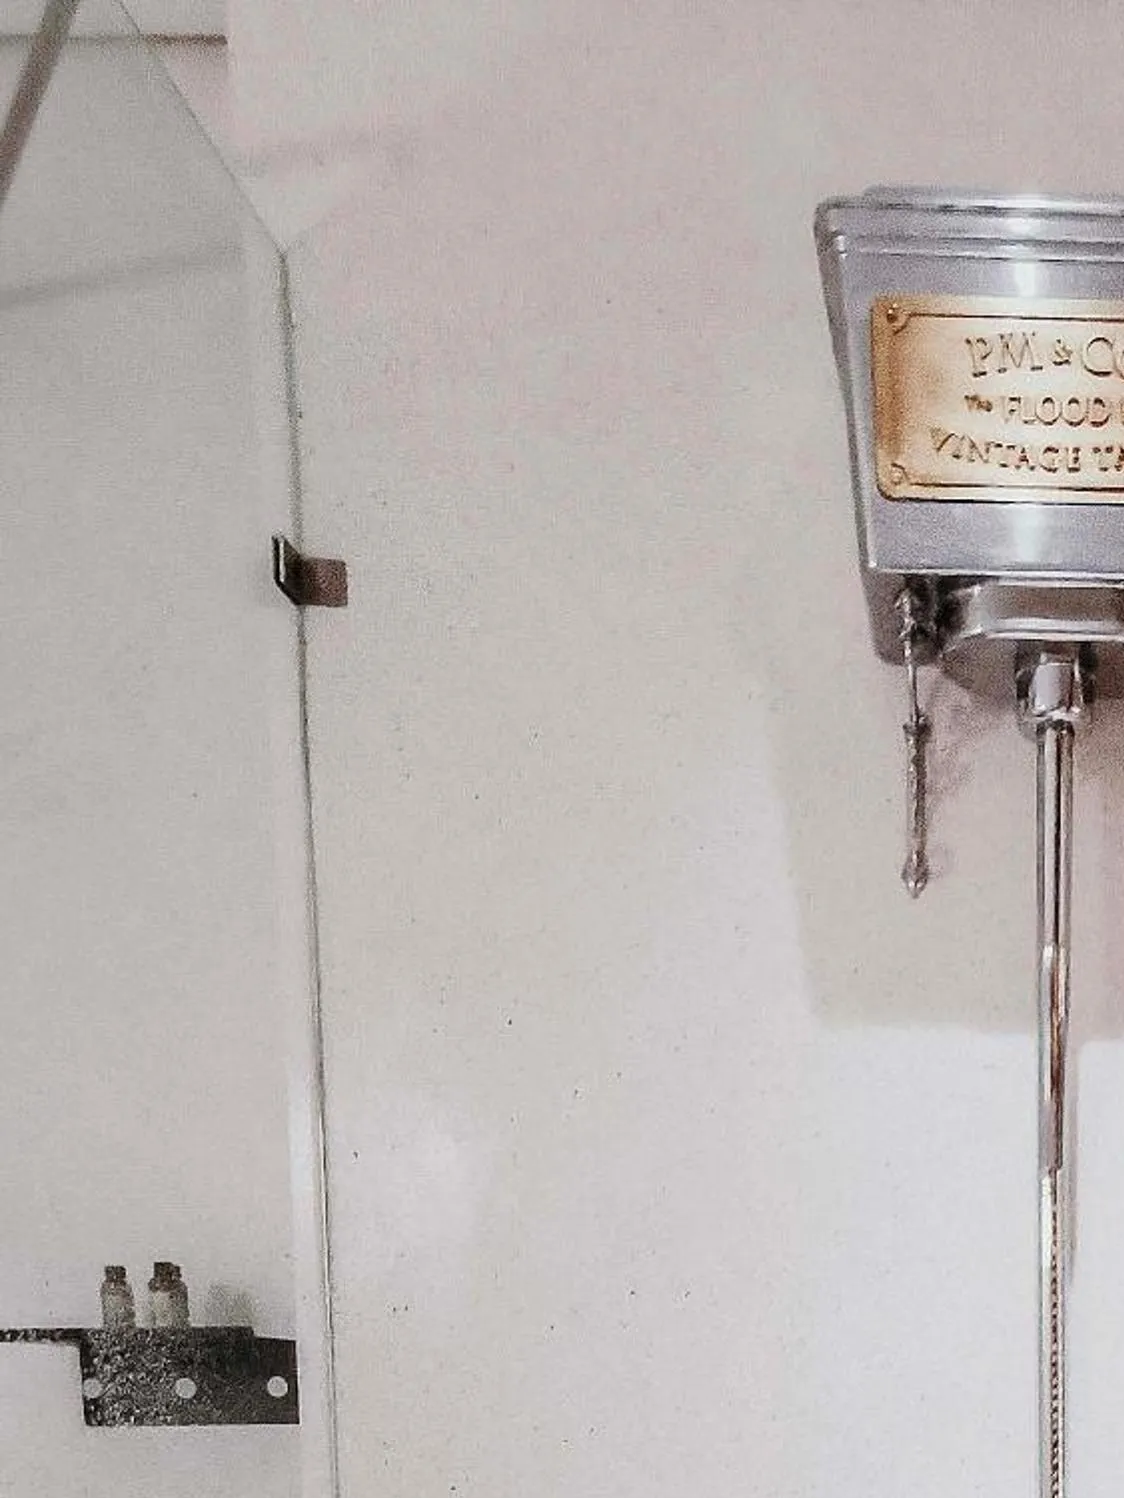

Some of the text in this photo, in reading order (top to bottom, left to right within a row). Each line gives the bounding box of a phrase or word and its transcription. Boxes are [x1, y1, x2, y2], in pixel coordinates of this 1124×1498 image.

[964, 331, 1044, 378] PM
[998, 396, 1112, 428] FLOOD
[930, 425, 1082, 474] VINTAGE
